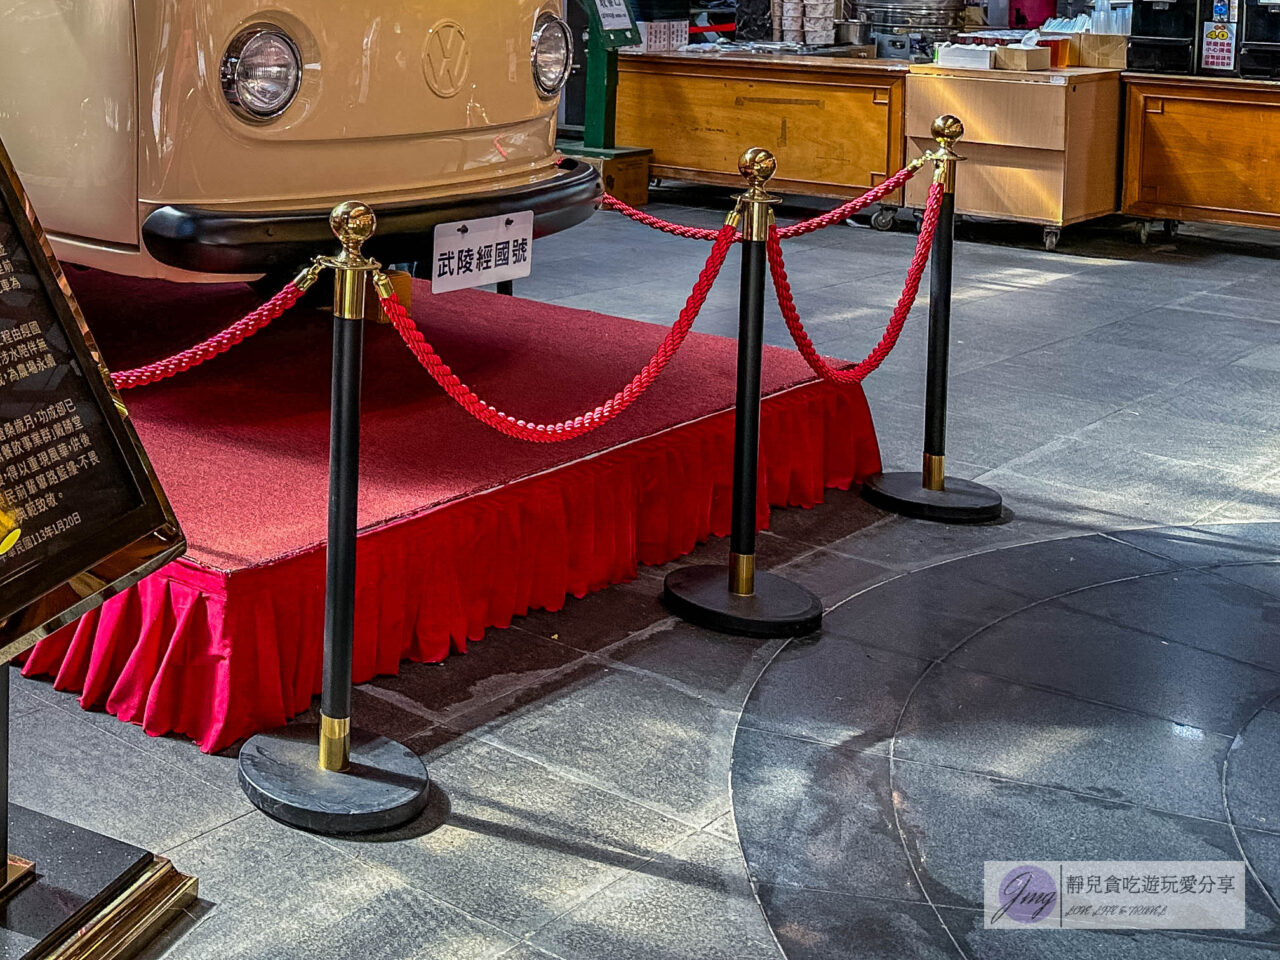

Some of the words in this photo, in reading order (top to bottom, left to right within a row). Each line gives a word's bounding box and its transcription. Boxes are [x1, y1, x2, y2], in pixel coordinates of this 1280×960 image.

[437, 238, 528, 278] 武陵經國號
